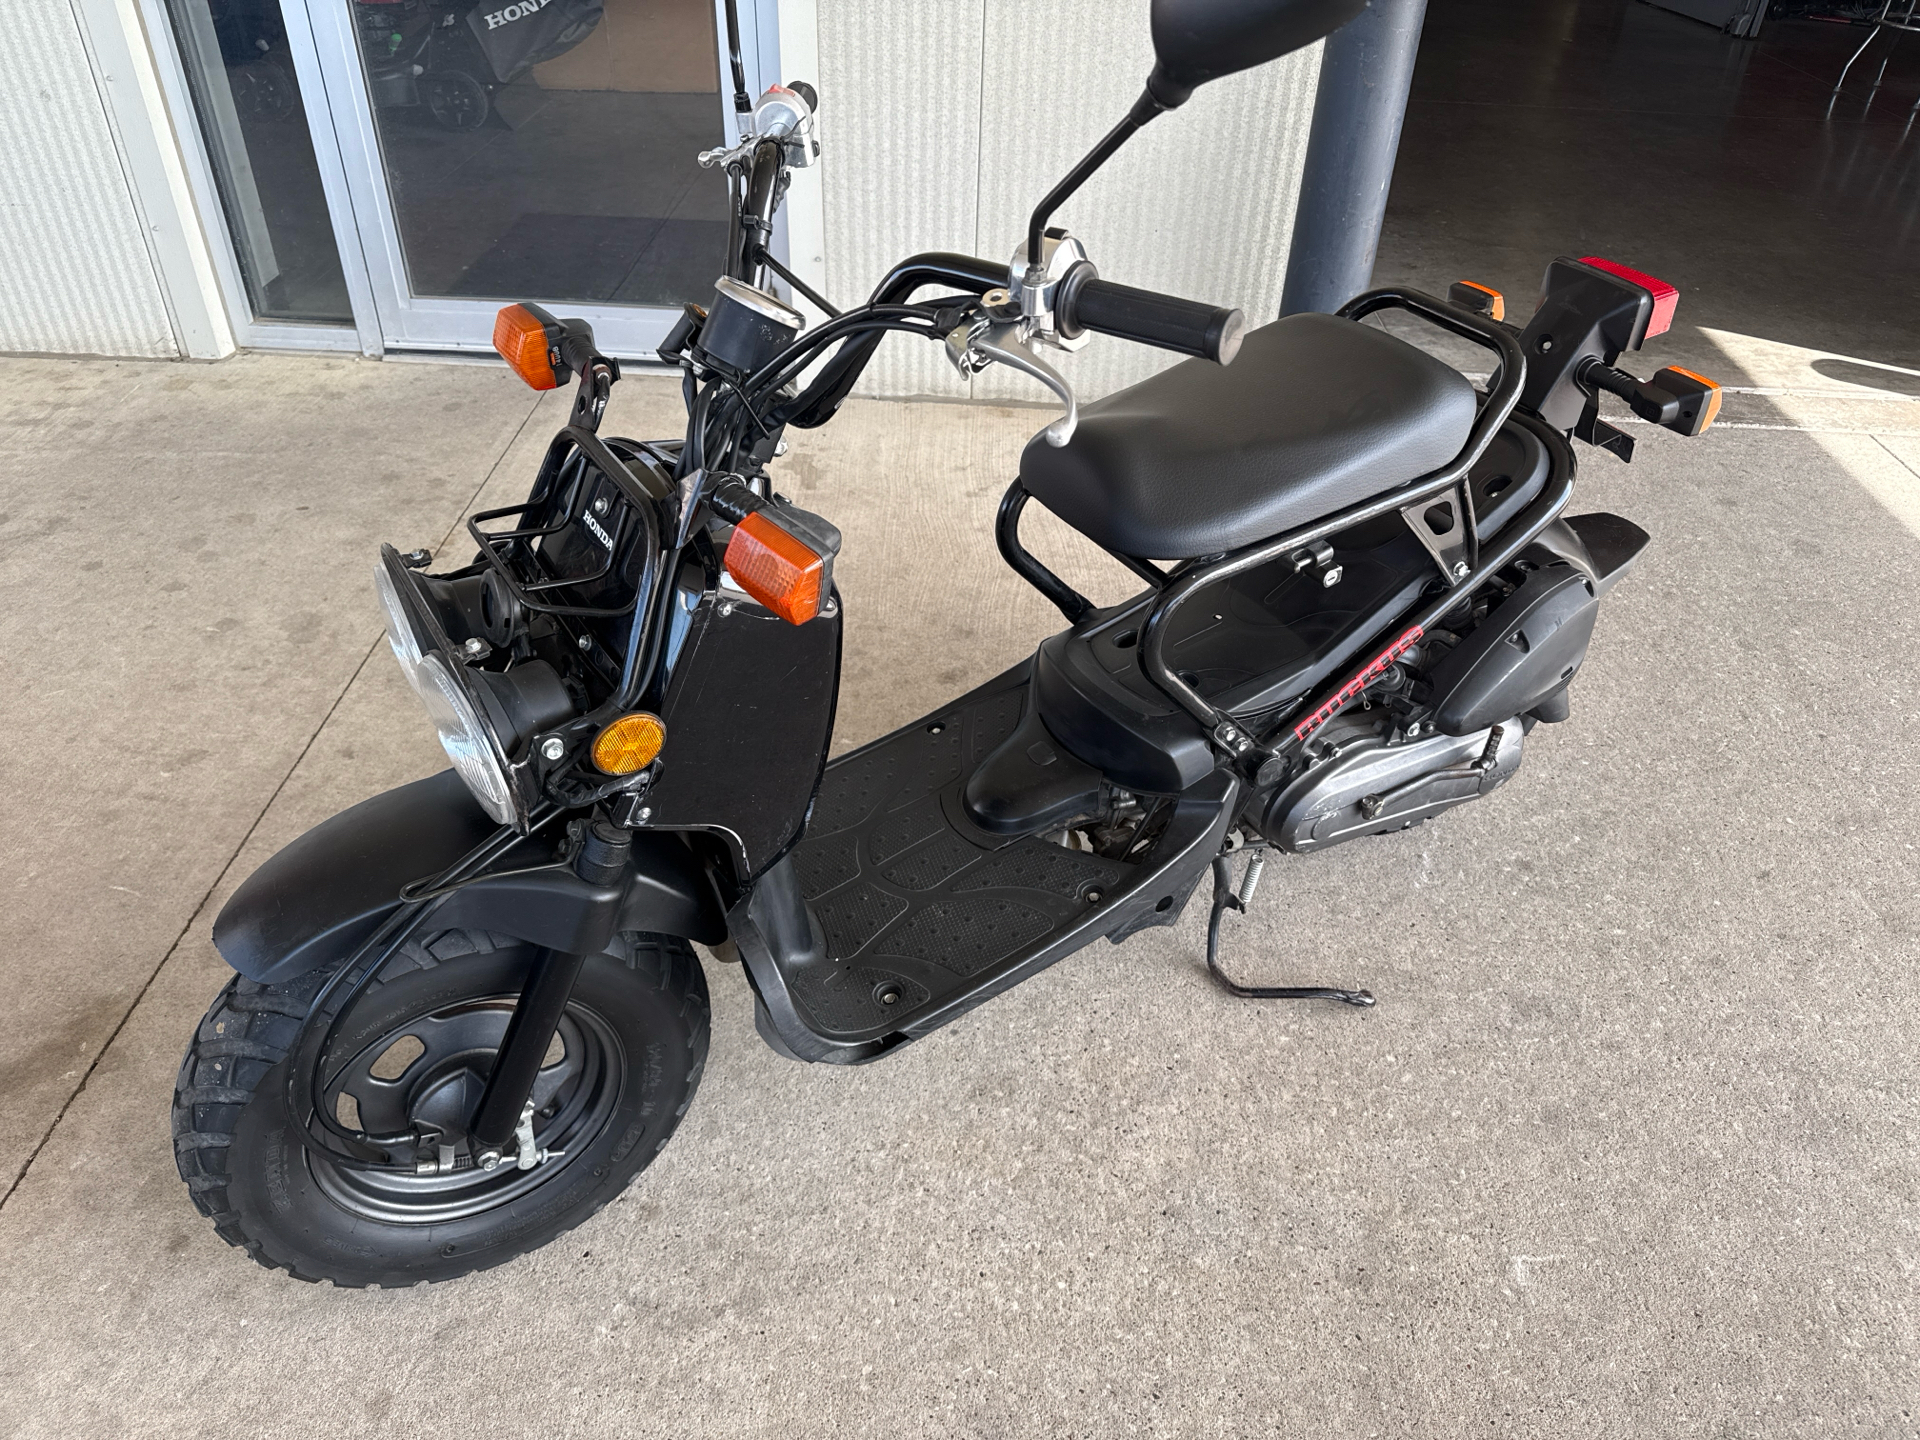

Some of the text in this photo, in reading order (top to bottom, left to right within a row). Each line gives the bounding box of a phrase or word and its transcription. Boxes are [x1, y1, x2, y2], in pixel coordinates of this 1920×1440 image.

[484, 0, 551, 30] HON
[583, 509, 614, 551] HONDA
[1294, 624, 1424, 741] RUCKUS
